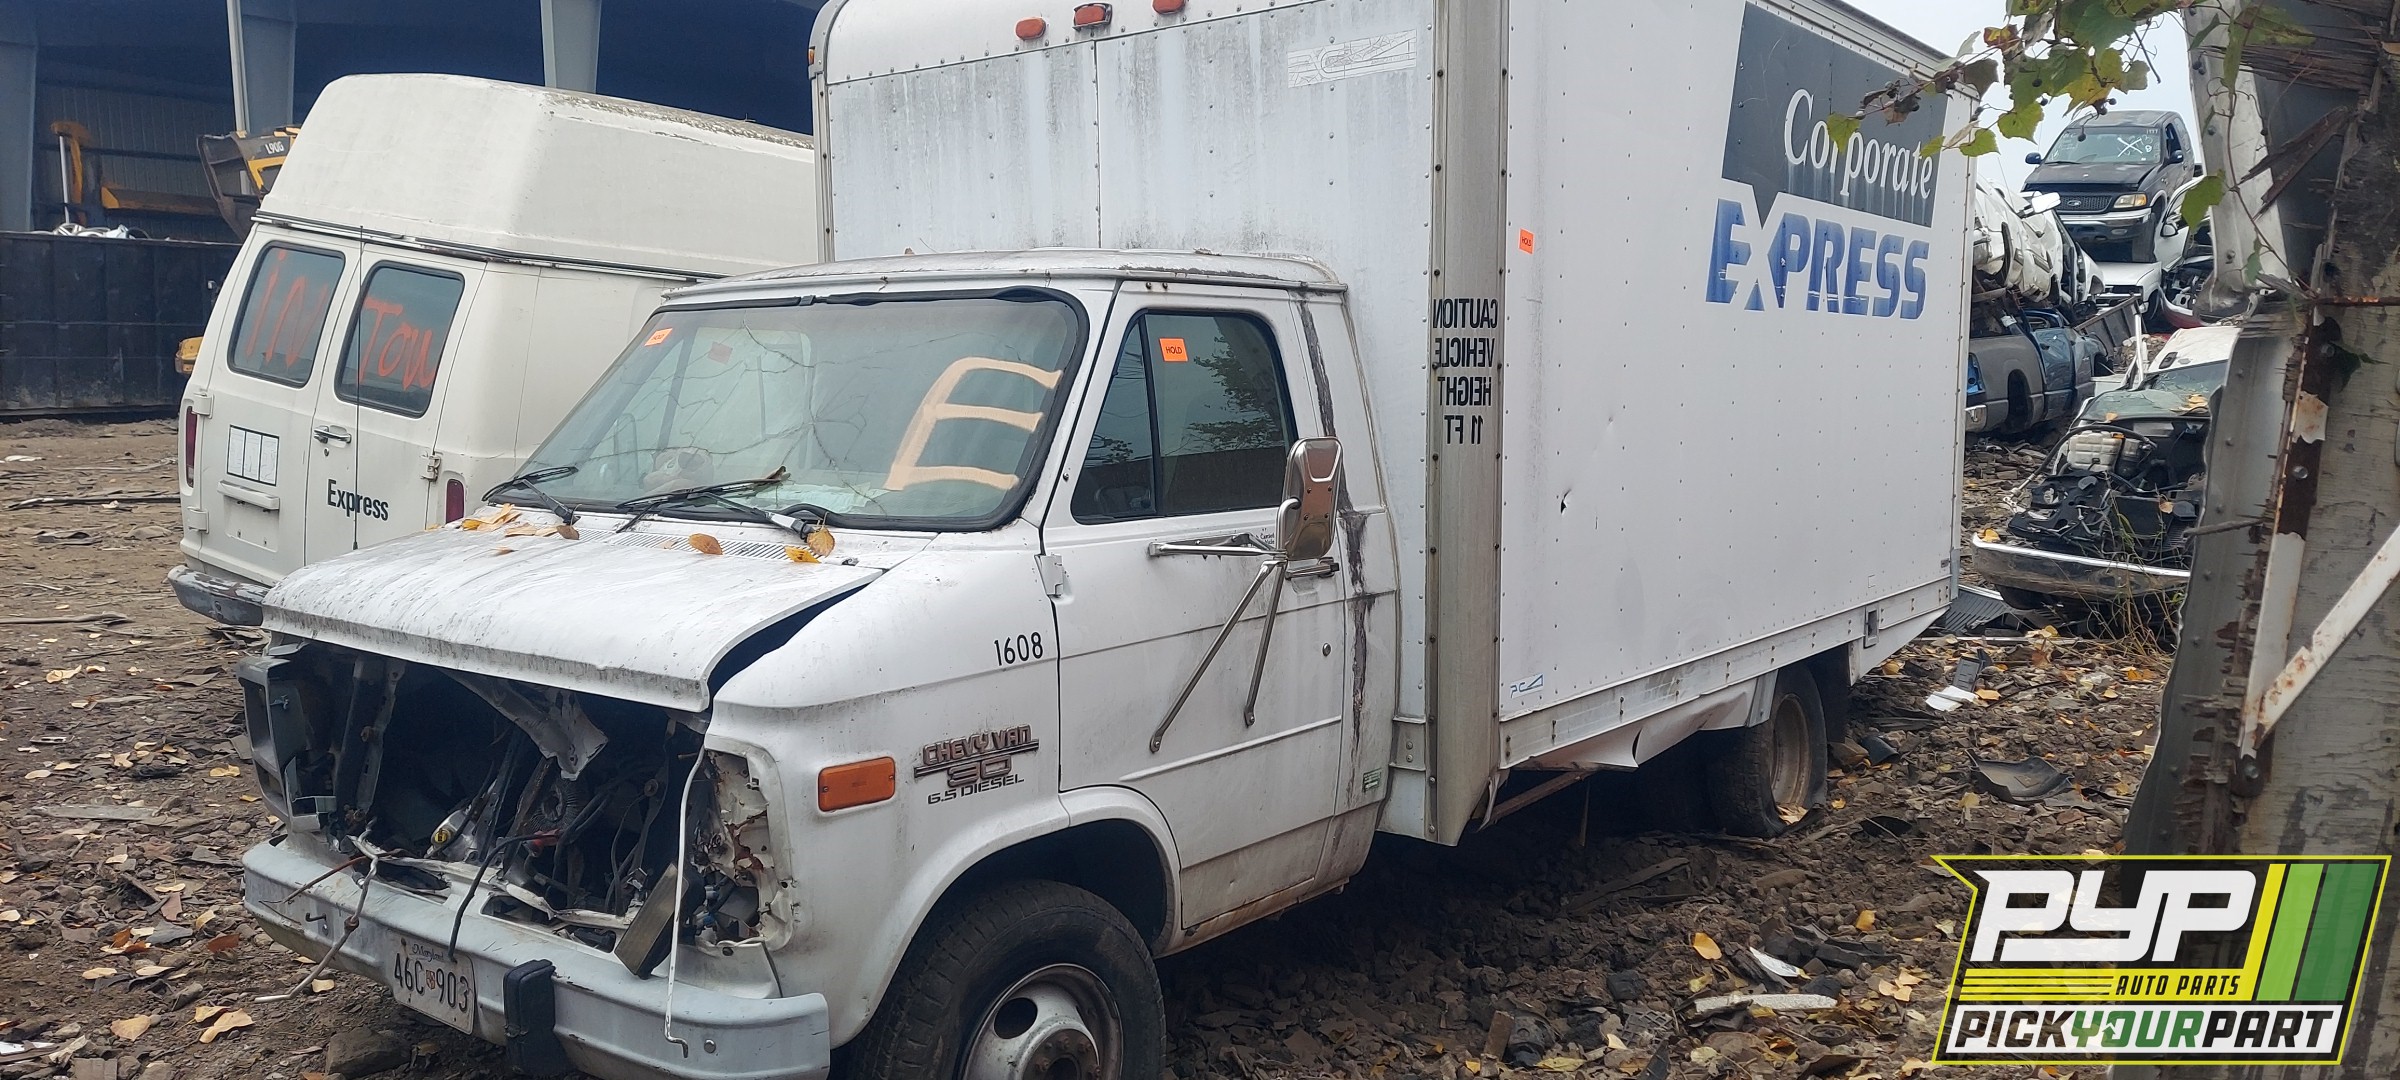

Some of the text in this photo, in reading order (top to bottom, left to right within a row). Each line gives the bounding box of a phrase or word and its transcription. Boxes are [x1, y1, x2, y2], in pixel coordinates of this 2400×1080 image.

[1705, 198, 1930, 320] EXPRESS
[1166, 346, 1183, 354] HOLD
[884, 357, 1063, 490] E
[327, 478, 389, 521] Express
[994, 631, 1043, 666] 1608
[923, 725, 1032, 766] CHEVY VAN
[927, 773, 1024, 804] 6.5 DIESEL
[394, 953, 468, 1012] 46C 903
